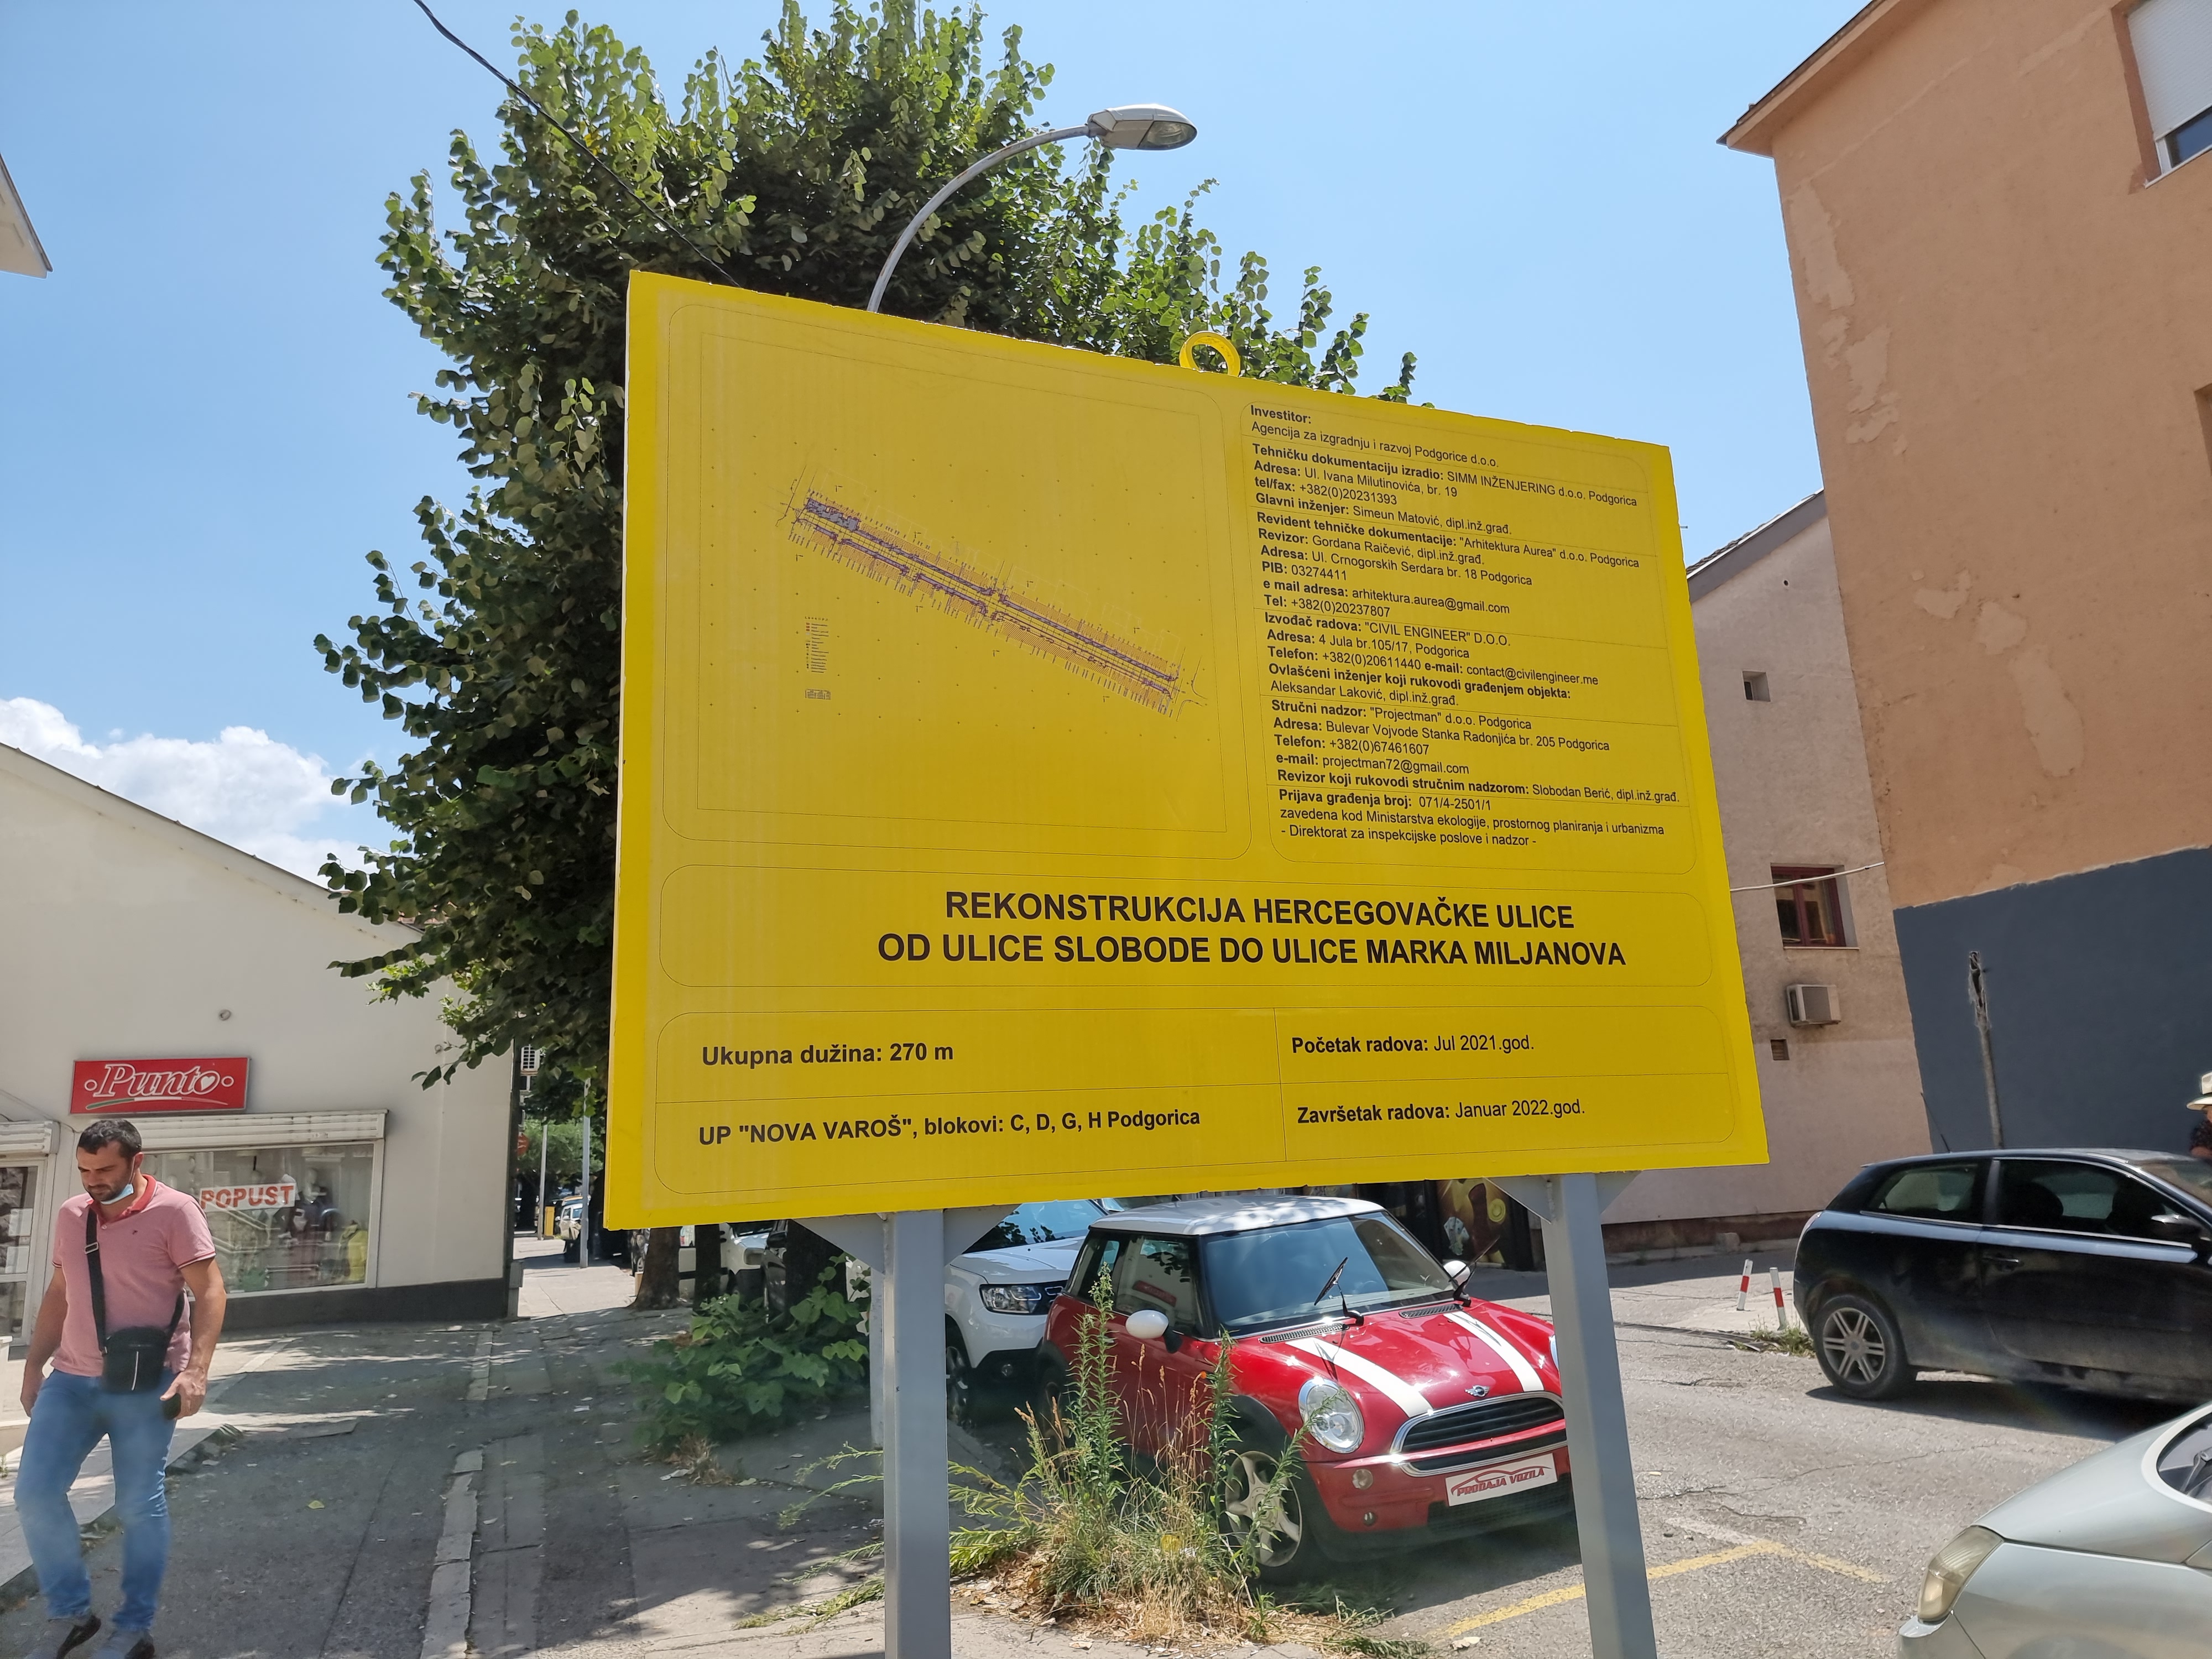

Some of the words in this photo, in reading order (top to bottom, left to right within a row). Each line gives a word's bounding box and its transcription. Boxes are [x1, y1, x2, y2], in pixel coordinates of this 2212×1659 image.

[1250, 404, 1311, 424] Investitor:
[1251, 420, 1300, 440] Agencija
[1303, 431, 1317, 441] za
[1319, 430, 1370, 451] izgradnju
[1379, 442, 1411, 458] razvoj
[1414, 445, 1468, 463] Podgorice
[1470, 453, 1499, 468] d.o.o.
[1251, 442, 1308, 462] Tehničku
[1311, 452, 1398, 476] dokumentaciju
[1401, 464, 1443, 481] izradio:
[1447, 470, 1478, 485] SIMM
[1480, 474, 1556, 495] INŽENJERING
[1558, 486, 1585, 500] d.o.o.
[1588, 490, 1637, 507] Podgorica
[1253, 459, 1301, 477] Adresa:
[1304, 466, 1319, 479] Ul.
[1323, 469, 1354, 484] Ivana
[1357, 473, 1424, 495] Milutinovića,
[1426, 483, 1441, 495] br.
[1444, 486, 1457, 497] 19
[1254, 476, 1295, 492] tel/fax:
[1299, 483, 1397, 505] +382(0)20231393
[1255, 492, 1295, 508] Glavni
[1297, 497, 1349, 515] inženjer:
[1352, 505, 1395, 520] Simeun
[1397, 510, 1442, 528] Matović,
[1445, 517, 1512, 535] dipl.inž.građ.
[1256, 510, 1311, 529] Revident
[1313, 519, 1365, 535] tehničke
[1368, 525, 1457, 548] dokumentacije:
[1459, 536, 1520, 554] "Arhitektura
[1522, 544, 1556, 557] Aurea"
[1559, 549, 1587, 562] d.o.o.
[1589, 552, 1640, 568] Podgorica
[1258, 527, 1308, 545] Revizor:
[1312, 534, 1361, 551] Gordana
[1364, 540, 1414, 559] Raičević,
[1416, 547, 1484, 565] dipl.inž.građ.
[1260, 544, 1308, 561] Adresa:
[1311, 550, 1327, 563] Ul.
[1330, 552, 1397, 571] Crnogorskih
[1400, 560, 1444, 576] Serdara
[1446, 565, 1461, 578] br.
[1464, 567, 1477, 580] 18
[1480, 569, 1532, 586] Podgorica
[1261, 560, 1287, 575] PIB:
[1291, 564, 1347, 581] 03274411
[1262, 580, 1270, 589] e
[1274, 580, 1300, 592] mail
[1303, 582, 1348, 597] adresa:
[1352, 588, 1510, 614] arhitektura.aurea@gmail.com
[1263, 593, 1287, 608] Tel:
[1290, 597, 1390, 618] +382(0)20237807
[1264, 611, 1313, 627] Izvođač
[1316, 618, 1361, 632] radova:
[1364, 620, 1401, 635] "CIVIL
[1403, 625, 1470, 643] ENGINEER"
[1473, 632, 1510, 646] D.O.O.
[1266, 628, 1315, 644] Adresa:
[1318, 633, 1326, 645] 4
[1329, 634, 1353, 648] Jula
[1355, 637, 1412, 655] br.105/17,
[1415, 642, 1470, 659] Podgorica
[1266, 645, 1318, 661] Telefon:
[1322, 650, 1421, 670] +382(0)20611440
[1423, 661, 1463, 674] e-mail:
[1466, 665, 1598, 685] contact@civilengineer.me
[1268, 662, 1331, 679] Ovlašćeni
[1333, 667, 1382, 685] inženjer
[1384, 672, 1406, 688] koji
[1409, 675, 1461, 690] rukovodi
[1464, 681, 1524, 697] građenjem
[1526, 685, 1571, 700] objekta:
[1270, 679, 1336, 696] Aleksandar
[1339, 685, 1386, 702] Laković,
[1389, 689, 1459, 707] dipl.inž.građ.
[1271, 698, 1317, 714] Stručni
[1320, 704, 1366, 717] nadzor:
[1369, 706, 1442, 723] "Projectman"
[1444, 712, 1475, 726] d.o.o.
[1478, 714, 1532, 731] Podgorica
[1272, 716, 1322, 731] Adresa:
[1326, 719, 1370, 734] Bulevar
[1371, 723, 1418, 739] Vojvode
[1421, 727, 1460, 741] Stanka
[1462, 729, 1516, 747] Radonjića
[1518, 734, 1533, 746] br.
[1535, 735, 1556, 748] 205
[1557, 737, 1610, 752] Podgorica
[1273, 733, 1326, 749] Telefon:
[1329, 738, 1430, 755] +382(0)67461607
[1275, 753, 1318, 765] e-mail:
[1322, 754, 1469, 774] projectman72@gmail.com
[1277, 769, 1326, 783] Revizor
[1328, 771, 1352, 787] koji
[1354, 774, 1409, 788] rukovodi
[1411, 777, 1465, 791] stručnim
[1468, 780, 1529, 795] nadzorom:
[1532, 783, 1582, 797] Slobodan
[1583, 786, 1614, 801] Berić,
[1615, 788, 1679, 804] dipl.inž.građ.
[1279, 788, 1323, 804] Prijava
[1326, 792, 1381, 808] građenja
[1383, 794, 1412, 810] broj:
[1418, 795, 1490, 811] 071/4-2501/1
[1280, 807, 1338, 821] zavedena
[1340, 808, 1363, 822] kod
[1366, 810, 1434, 825] Ministarstva
[1437, 813, 1489, 830] ekologije,
[1492, 817, 1550, 833] prostornog
[1552, 819, 1603, 835] planiranja
[1611, 822, 1665, 835] urbanizma
[1289, 824, 1348, 838] Direktorat
[1350, 829, 1365, 839] za
[1367, 827, 1437, 844] inspekcijske
[1439, 831, 1483, 846] poslove
[1491, 833, 1530, 846] nadzor
[946, 891, 1246, 923] REKONSTRUKCIJA
[1254, 896, 1489, 927] HERCEGOVAČKE
[1496, 904, 1574, 928] ULICE
[878, 933, 930, 962] OD
[943, 934, 1044, 962] ULICE
[1054, 935, 1211, 963] SLOBODE
[1219, 937, 1263, 963] DO
[1272, 938, 1358, 964] ULICE
[1366, 939, 1468, 964] MARKA
[1474, 941, 1626, 966] MILJANOVA
[702, 1046, 792, 1070] Ukupna
[800, 1044, 881, 1064] dužina:
[890, 1042, 927, 1061] 270
[935, 1046, 953, 1060] m
[1292, 1036, 1362, 1053] Početak
[1366, 1036, 1428, 1052] radova:
[1433, 1035, 1455, 1051] Jul
[1460, 1034, 1534, 1054] 2021.god.
[93, 1064, 220, 1097] Punto
[700, 1126, 731, 1145] UP
[739, 1122, 817, 1143] "NOVA
[822, 1114, 917, 1140] VAROŠ",
[925, 1115, 1003, 1135] blokovi:
[1010, 1114, 1030, 1135] C,
[1036, 1114, 1056, 1134] D,
[1062, 1112, 1082, 1133] G,
[1088, 1112, 1102, 1129] H
[1108, 1109, 1201, 1131] Podgorica
[1297, 1104, 1383, 1124] Završetak
[1387, 1103, 1450, 1120] radova:
[1455, 1102, 1507, 1118] Januar
[1511, 1098, 1585, 1119] 2022.god.
[201, 1185, 294, 1209] POPUST
[1457, 1478, 1507, 1496] PRODAJA
[1509, 1468, 1545, 1484] VOZILA
